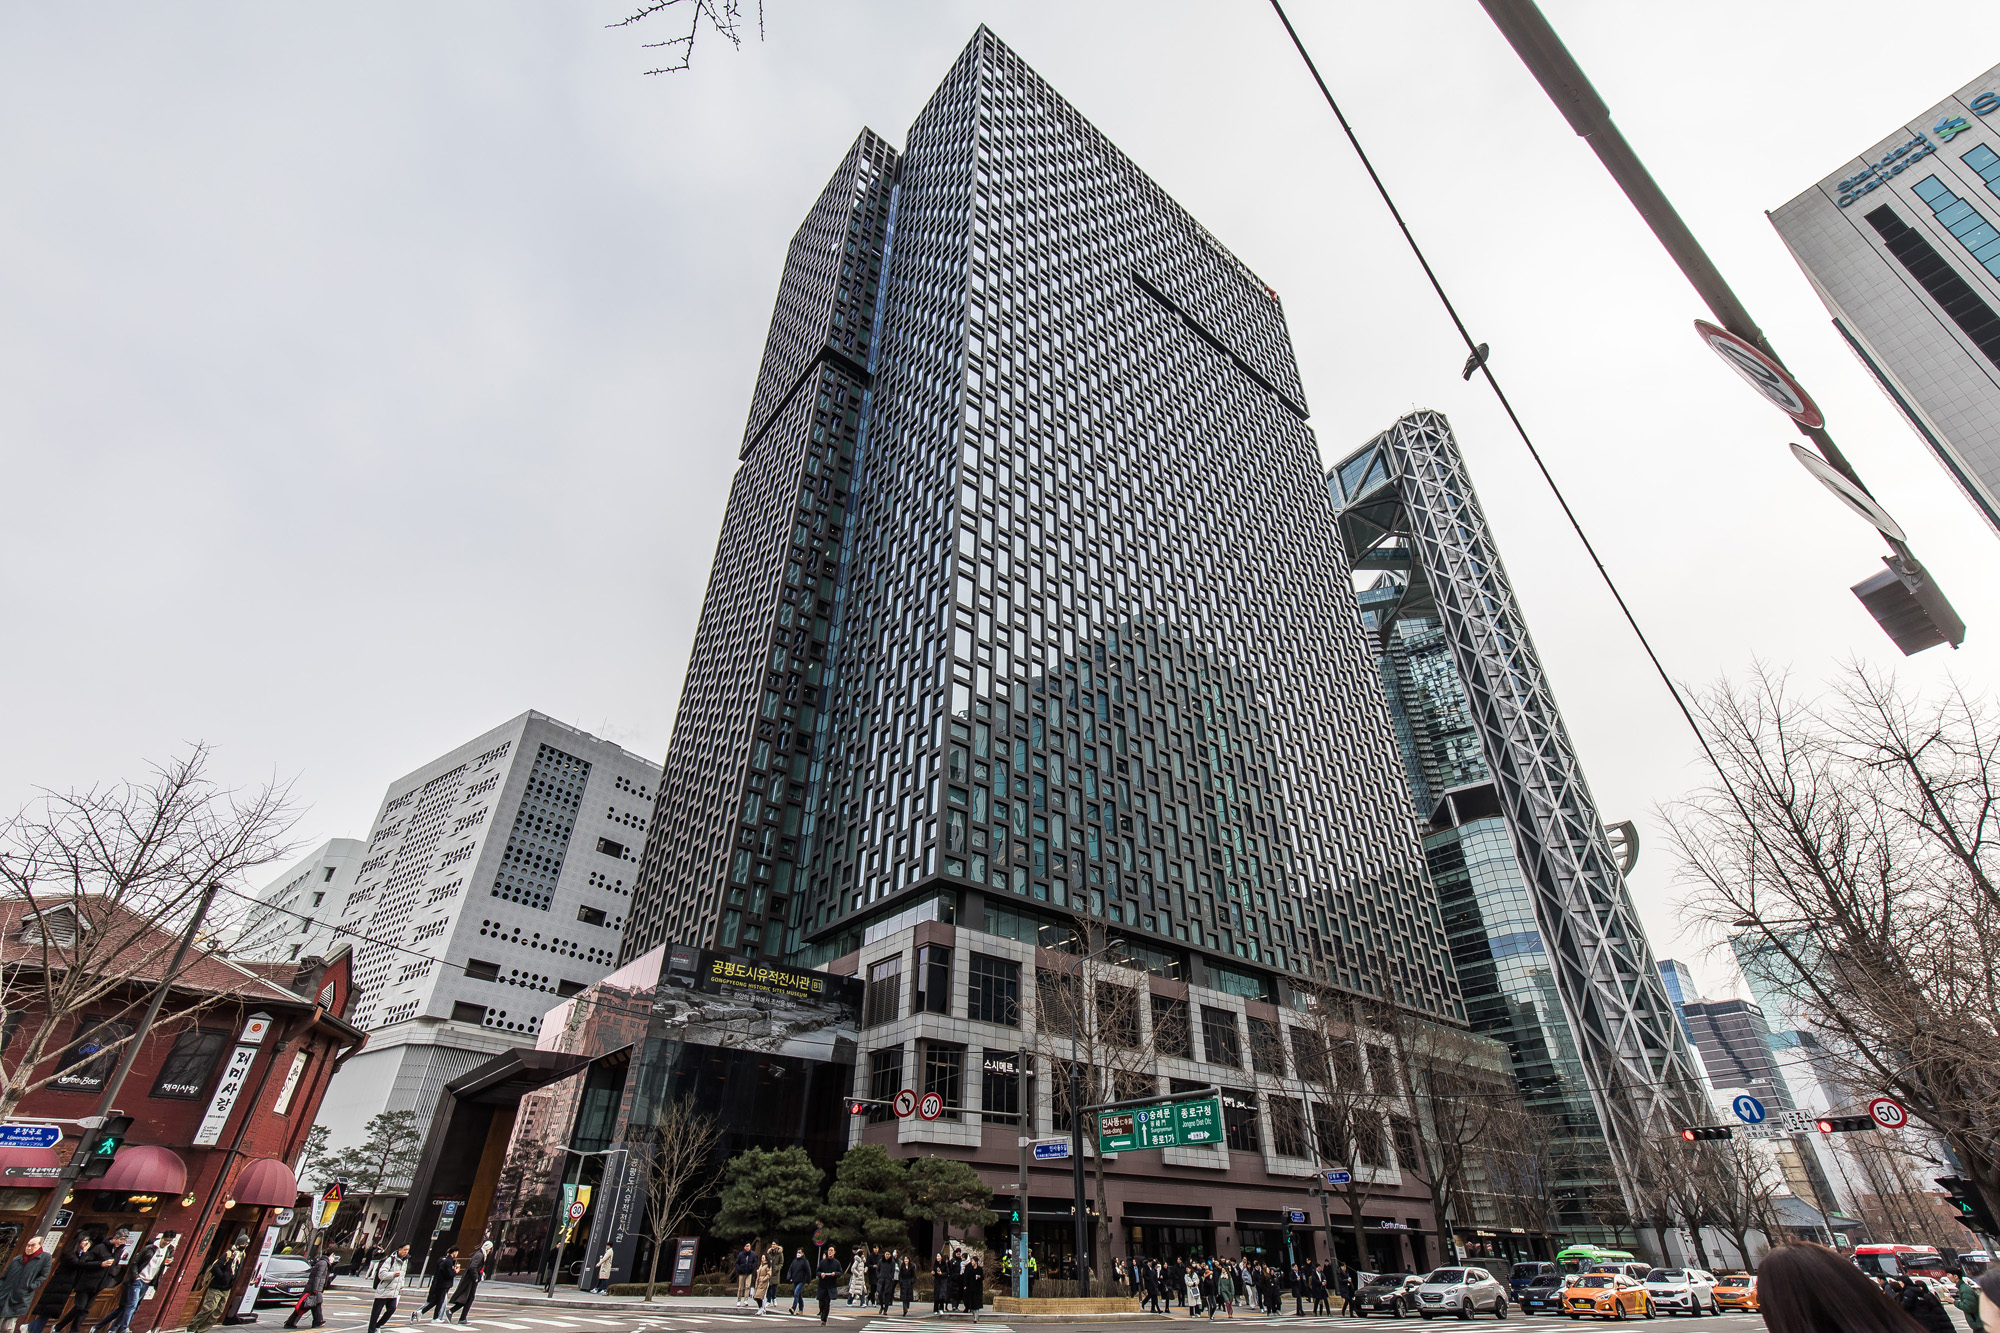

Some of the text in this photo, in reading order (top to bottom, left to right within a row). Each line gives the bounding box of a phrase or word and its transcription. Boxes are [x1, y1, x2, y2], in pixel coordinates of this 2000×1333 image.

[1837, 131, 1928, 194] Standard
[1838, 141, 1938, 208] Chartered
[712, 960, 810, 991] 공평도시유적전시관
[710, 976, 747, 988] GONGPYEONG
[748, 983, 771, 993] HISTORIC
[786, 989, 808, 998] MUSEUM
[984, 1059, 1014, 1073] 스시메르
[161, 1083, 199, 1094] 재미사랑
[216, 1051, 252, 1112] 재미사랑
[923, 1098, 938, 1115] 30
[1180, 1105, 1212, 1119] 종로구청
[1876, 1105, 1898, 1122] 50
[1149, 1108, 1171, 1120] 숭례문
[1102, 1117, 1120, 1128] 인사동
[1182, 1120, 1196, 1129] Jongno
[13, 1127, 42, 1136] 우정국로
[1152, 1133, 1175, 1145] 종로1가
[572, 1205, 582, 1215] 30
